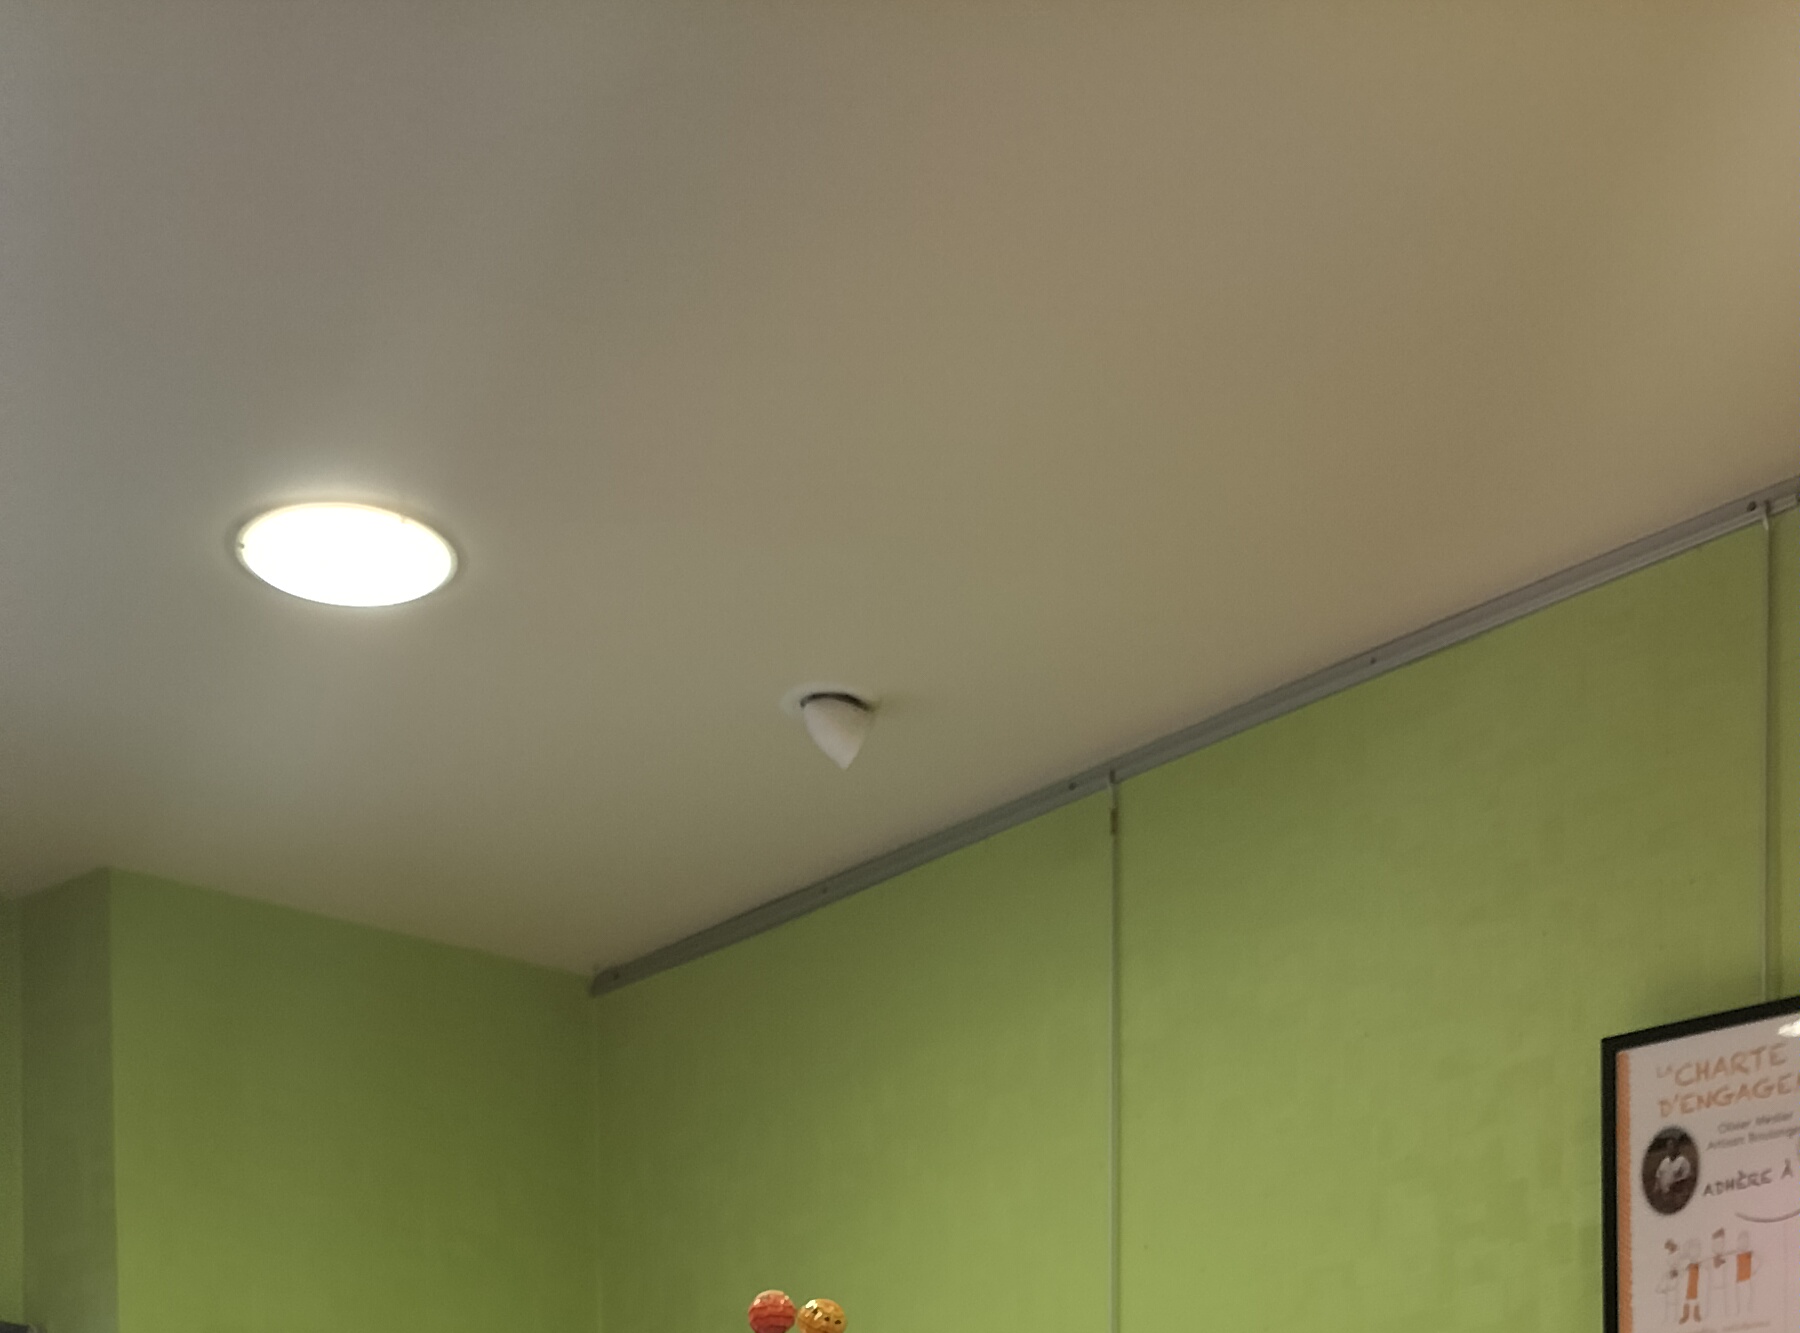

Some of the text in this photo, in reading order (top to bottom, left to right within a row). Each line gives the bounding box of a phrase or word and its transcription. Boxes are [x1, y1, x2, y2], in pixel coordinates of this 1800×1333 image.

[1674, 1042, 1788, 1087] CHARTE
[1658, 1072, 1800, 1118] D'ENGAGE
[1702, 1168, 1773, 1197] ADHÈRE
